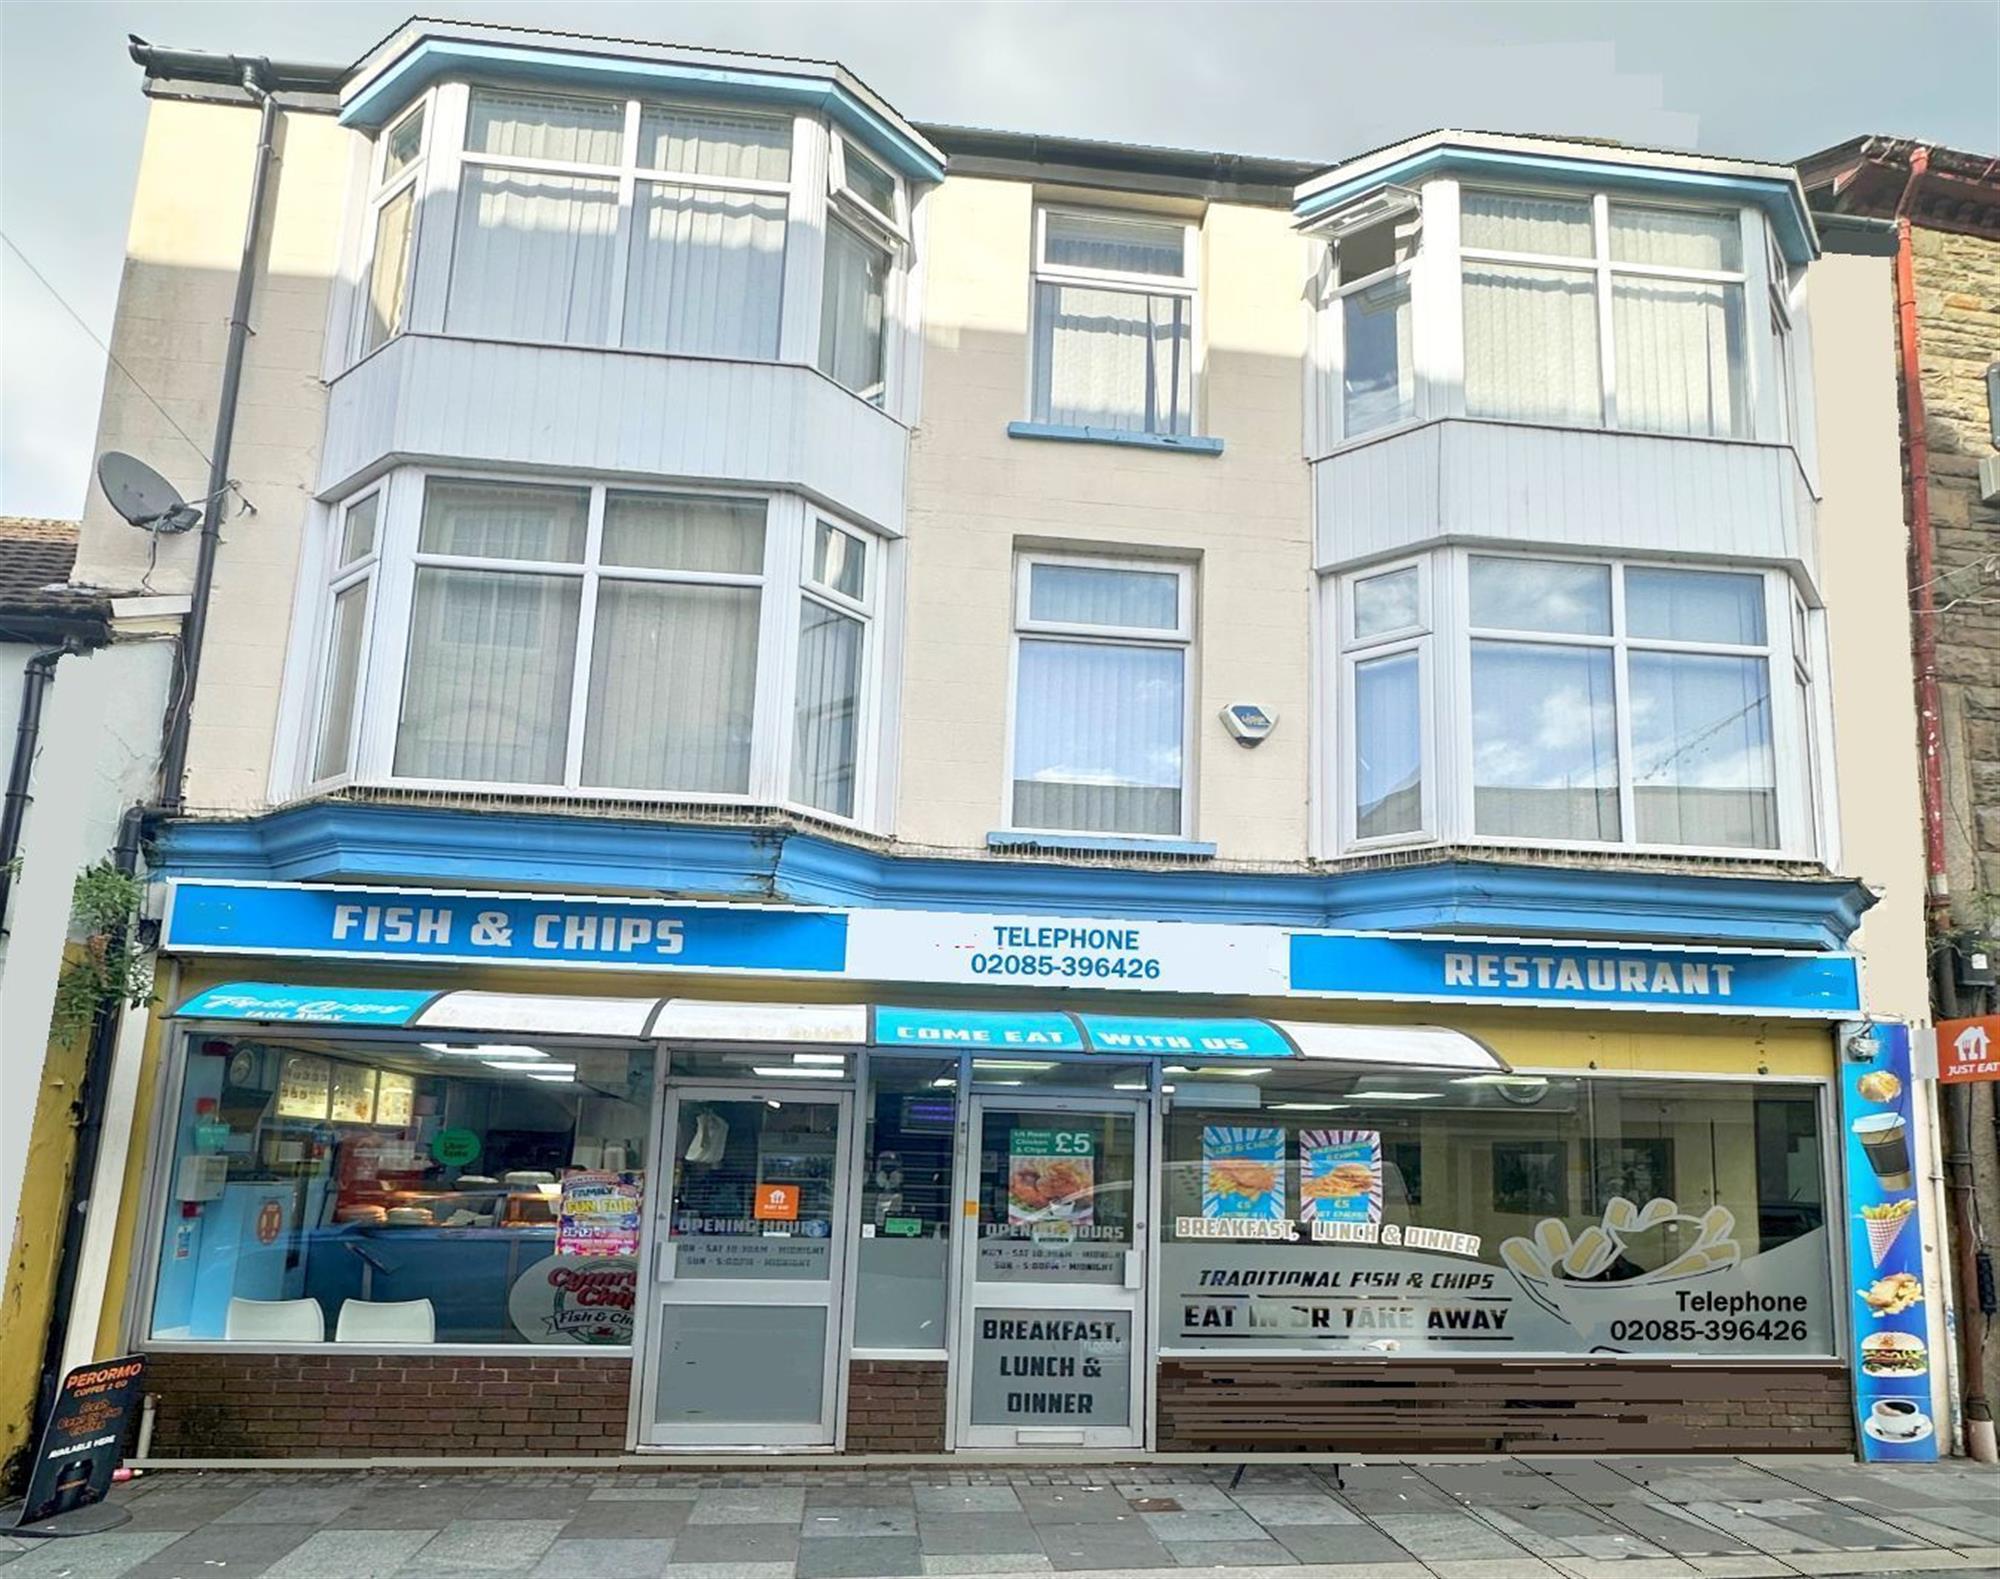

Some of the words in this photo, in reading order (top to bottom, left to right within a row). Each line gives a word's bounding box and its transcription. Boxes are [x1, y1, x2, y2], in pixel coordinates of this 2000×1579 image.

[332, 904, 453, 945] FISH
[469, 911, 513, 947] &
[533, 914, 685, 955] CHIPS
[993, 926, 1140, 951] TELEPHONE
[970, 953, 1161, 979] 02085-396426
[1444, 952, 1736, 996] RESTAURANT
[897, 1026, 991, 1043] COME
[1004, 1031, 1065, 1044] EAT
[1097, 1031, 1192, 1049] WITH
[1202, 1038, 1249, 1051] US
[1948, 1063, 1976, 1077] JUST
[1977, 1061, 2000, 1073] EAT
[1055, 1132, 1091, 1153] £5
[572, 1187, 614, 1197] FAMILY
[566, 1199, 597, 1213] FUN
[601, 1197, 636, 1213] FAIR
[678, 1217, 757, 1233] OPENING
[1177, 1217, 1299, 1241] BREAKFAST,
[1312, 1221, 1379, 1244] LUNCH
[1382, 1225, 1401, 1245] &
[1404, 1227, 1480, 1255] DINNER
[706, 1244, 723, 1253] SAT
[687, 1256, 706, 1265] SUN
[1069, 1262, 1114, 1271] MIDNIGHT
[1198, 1270, 1341, 1287] TRADITIONAL
[1350, 1271, 1400, 1288] FISH
[1406, 1273, 1424, 1288] &
[1430, 1273, 1495, 1290] CHIPS
[1675, 1290, 1808, 1317] Telephone
[560, 1311, 591, 1323] Fish
[594, 1312, 607, 1322] &
[1184, 1305, 1237, 1327] EAT
[1343, 1307, 1416, 1329] TAKE
[1428, 1308, 1509, 1330] AWAY
[983, 1319, 1121, 1343] BREAKFAST,
[1610, 1320, 1808, 1341] 02085-396426
[66, 1363, 142, 1389] PERORMO
[1000, 1356, 1075, 1377] LUNCH
[1083, 1357, 1102, 1378] &
[1007, 1392, 1093, 1414] DINNER
[48, 1441, 93, 1459] AVAILABLE
[93, 1434, 117, 1447] HERE
